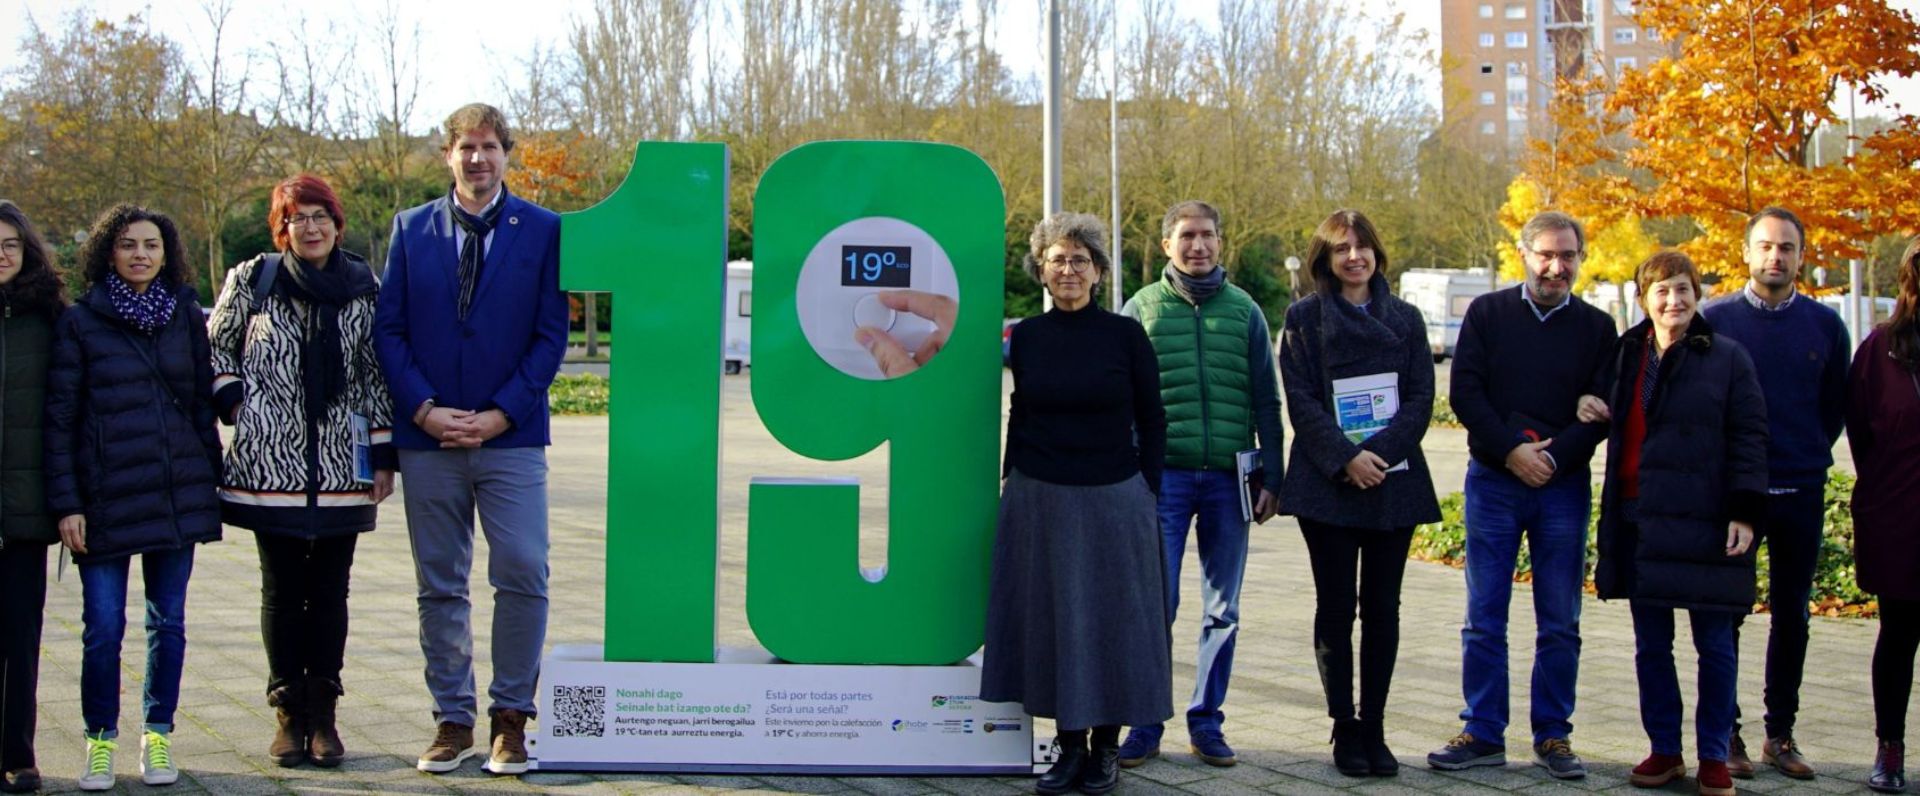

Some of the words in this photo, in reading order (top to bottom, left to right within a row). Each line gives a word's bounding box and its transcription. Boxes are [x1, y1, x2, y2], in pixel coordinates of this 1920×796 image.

[559, 140, 1005, 665] 19
[616, 688, 654, 698] Nonahi
[656, 689, 683, 701] dago
[766, 689, 787, 700] Está
[790, 691, 808, 703] por
[810, 690, 838, 701] todas
[841, 691, 873, 704] partes
[616, 702, 654, 712] Seinale
[657, 703, 674, 712] bat
[676, 703, 711, 715] izango
[713, 704, 731, 713] ote
[733, 703, 752, 713] da?
[765, 703, 793, 715] ¿Será
[796, 705, 815, 714] una
[817, 703, 849, 714] señal?
[615, 716, 656, 726] Aurtengo
[692, 717, 710, 726] jarri
[711, 717, 756, 727] berogailua
[765, 717, 781, 726] Este
[783, 717, 814, 726] invierno
[832, 718, 839, 726] la
[840, 718, 883, 727] calefacción
[671, 728, 709, 737] aurreztu
[795, 731, 800, 739] y
[801, 729, 828, 738] ahorra
